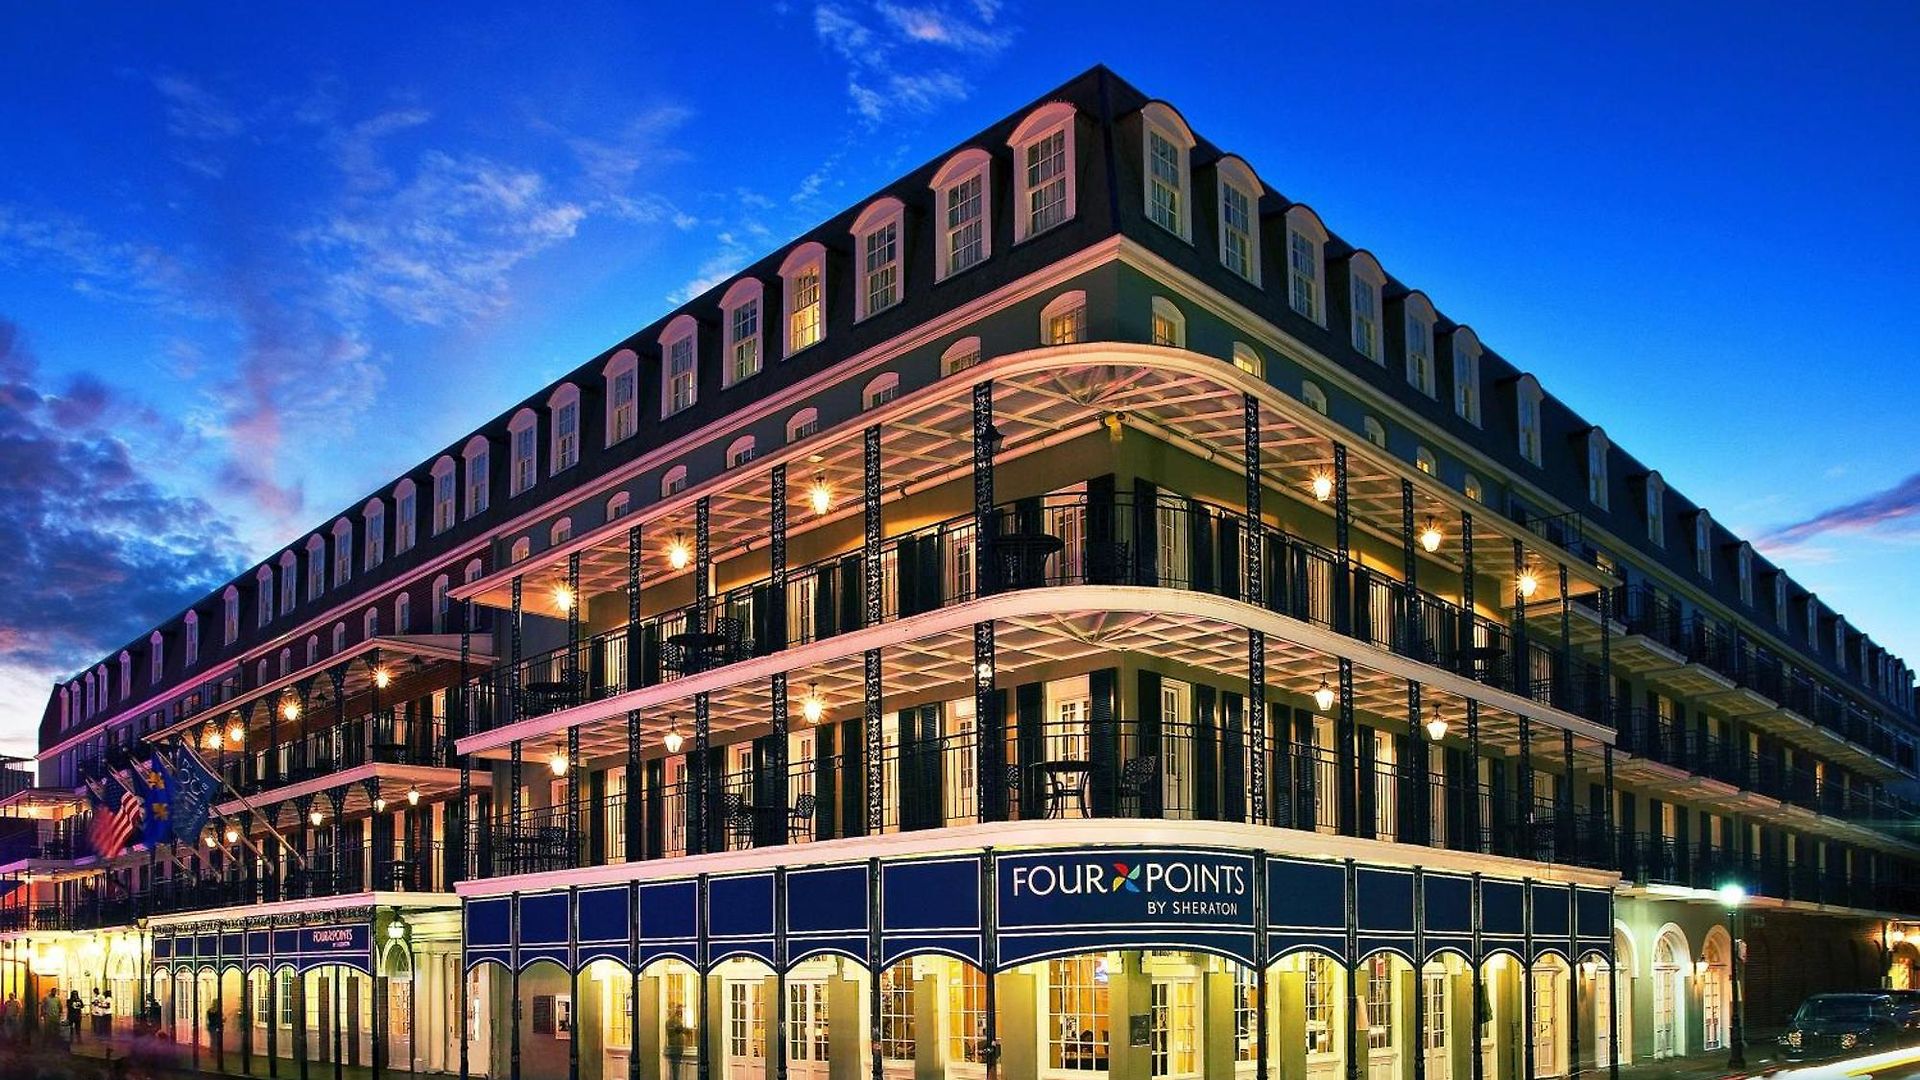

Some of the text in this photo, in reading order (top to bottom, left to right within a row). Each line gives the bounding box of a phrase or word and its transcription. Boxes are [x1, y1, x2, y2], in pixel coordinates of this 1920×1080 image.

[1013, 862, 1245, 896] FOUR POINTS
[1147, 901, 1238, 916] BY SHERATON
